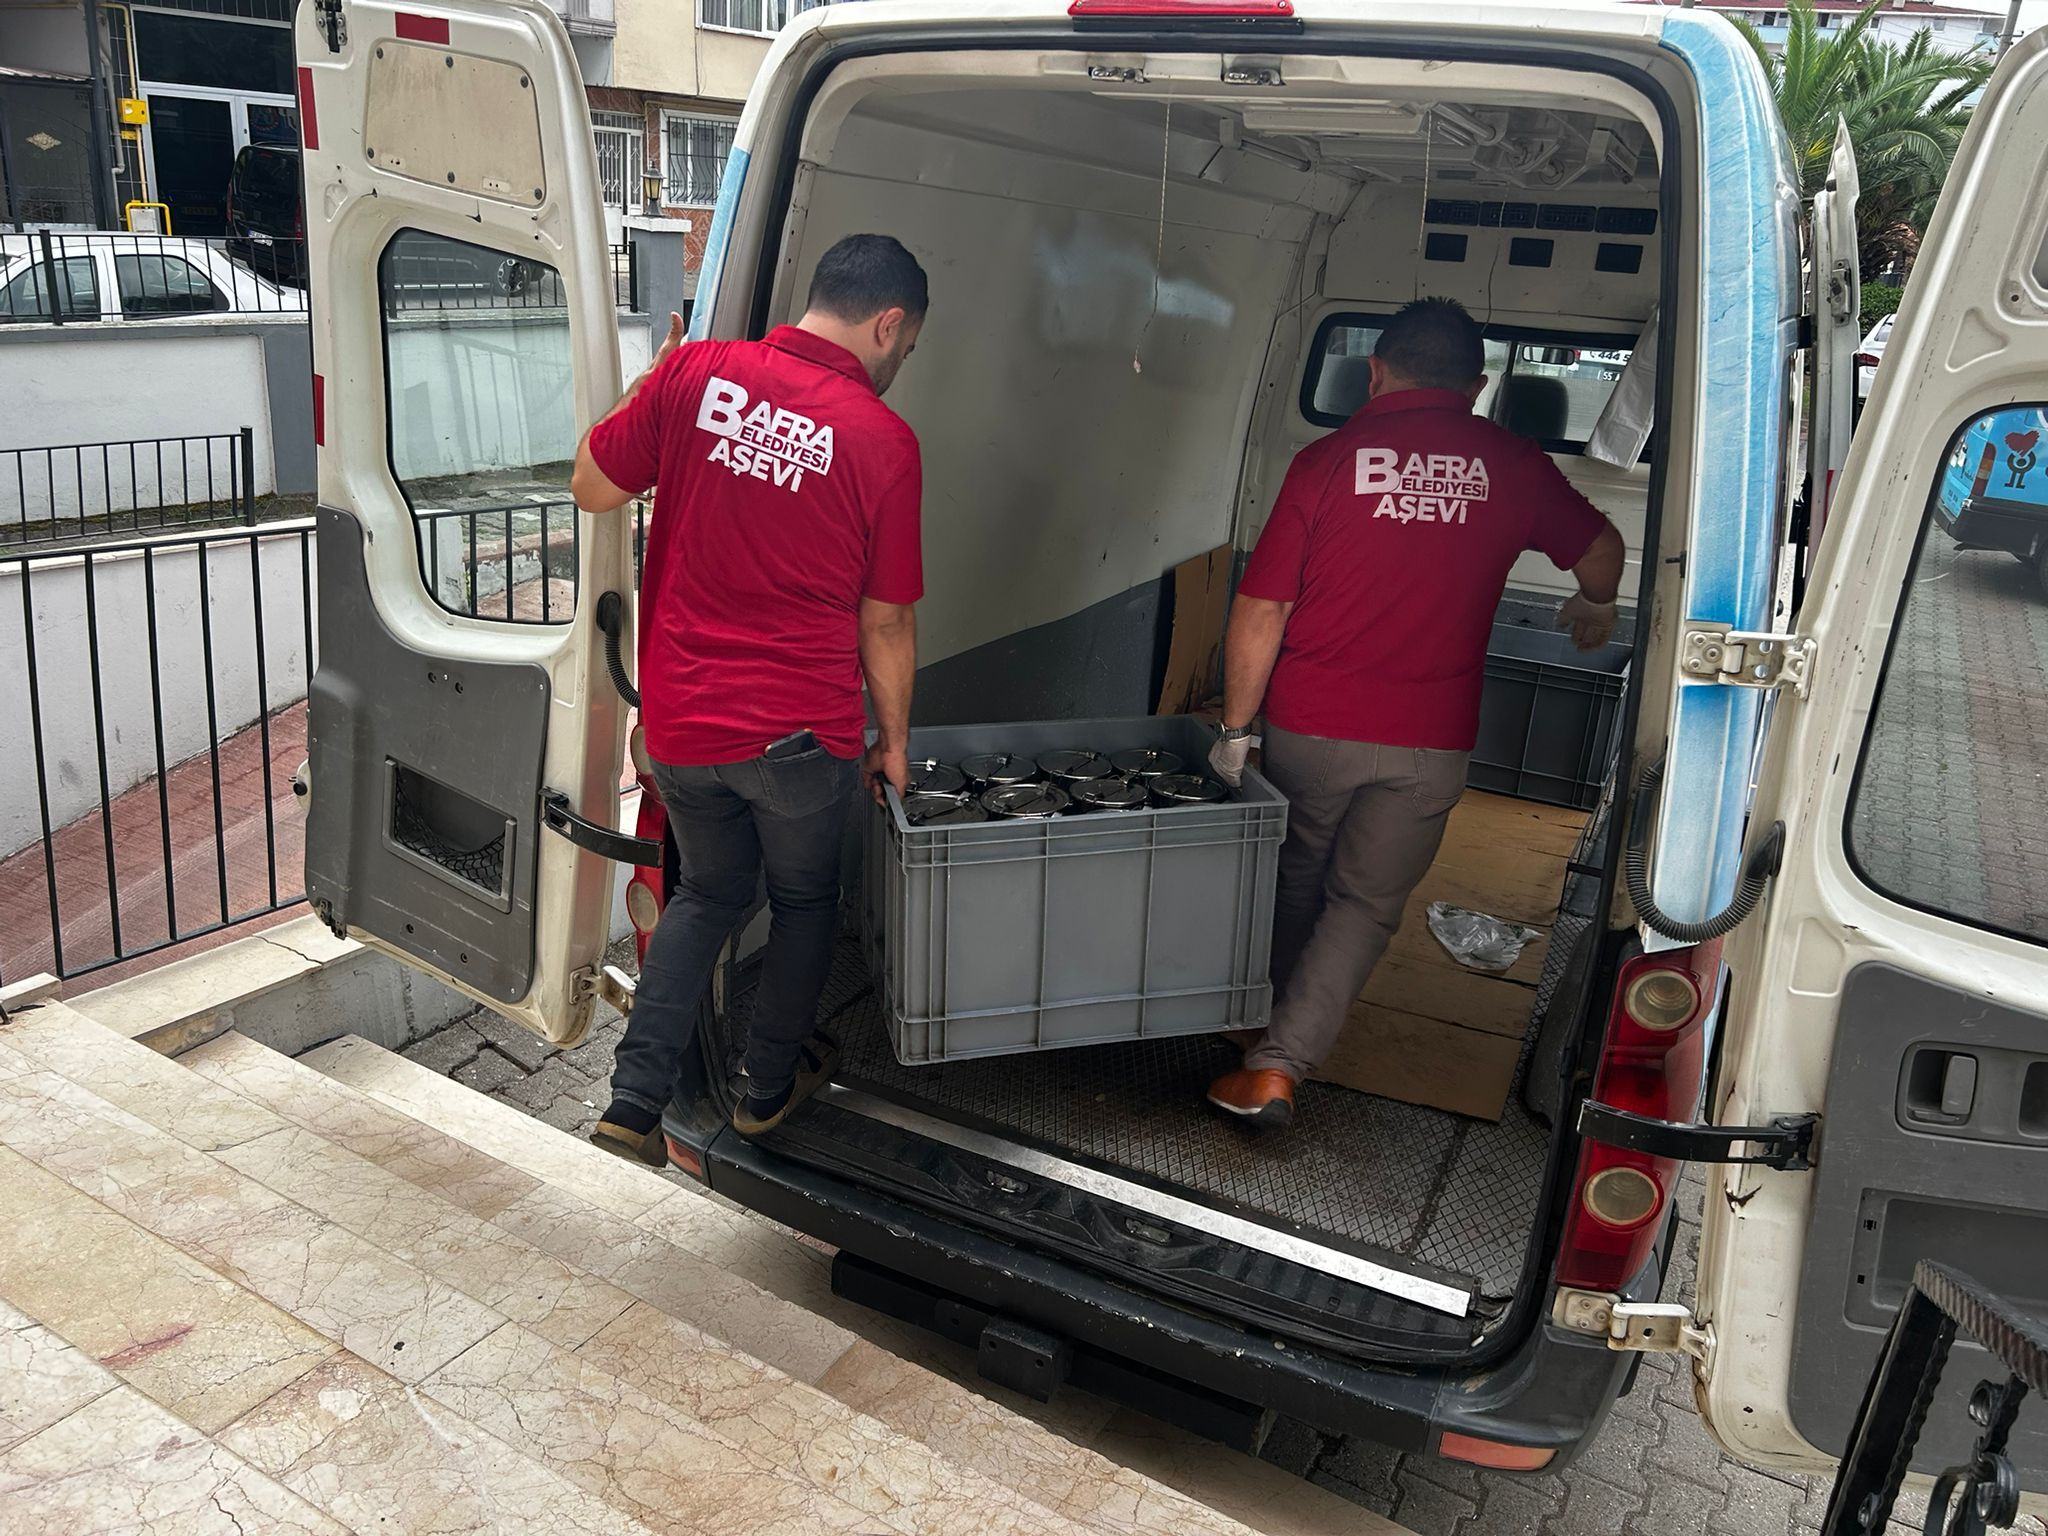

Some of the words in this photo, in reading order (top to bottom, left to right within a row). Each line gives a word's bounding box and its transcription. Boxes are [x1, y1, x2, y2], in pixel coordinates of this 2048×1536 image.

[696, 376, 834, 457] BAFRA
[707, 438, 804, 493] AŞEVİ
[1355, 448, 1489, 495] BAFRA
[1372, 494, 1468, 525] AŞEVİ
